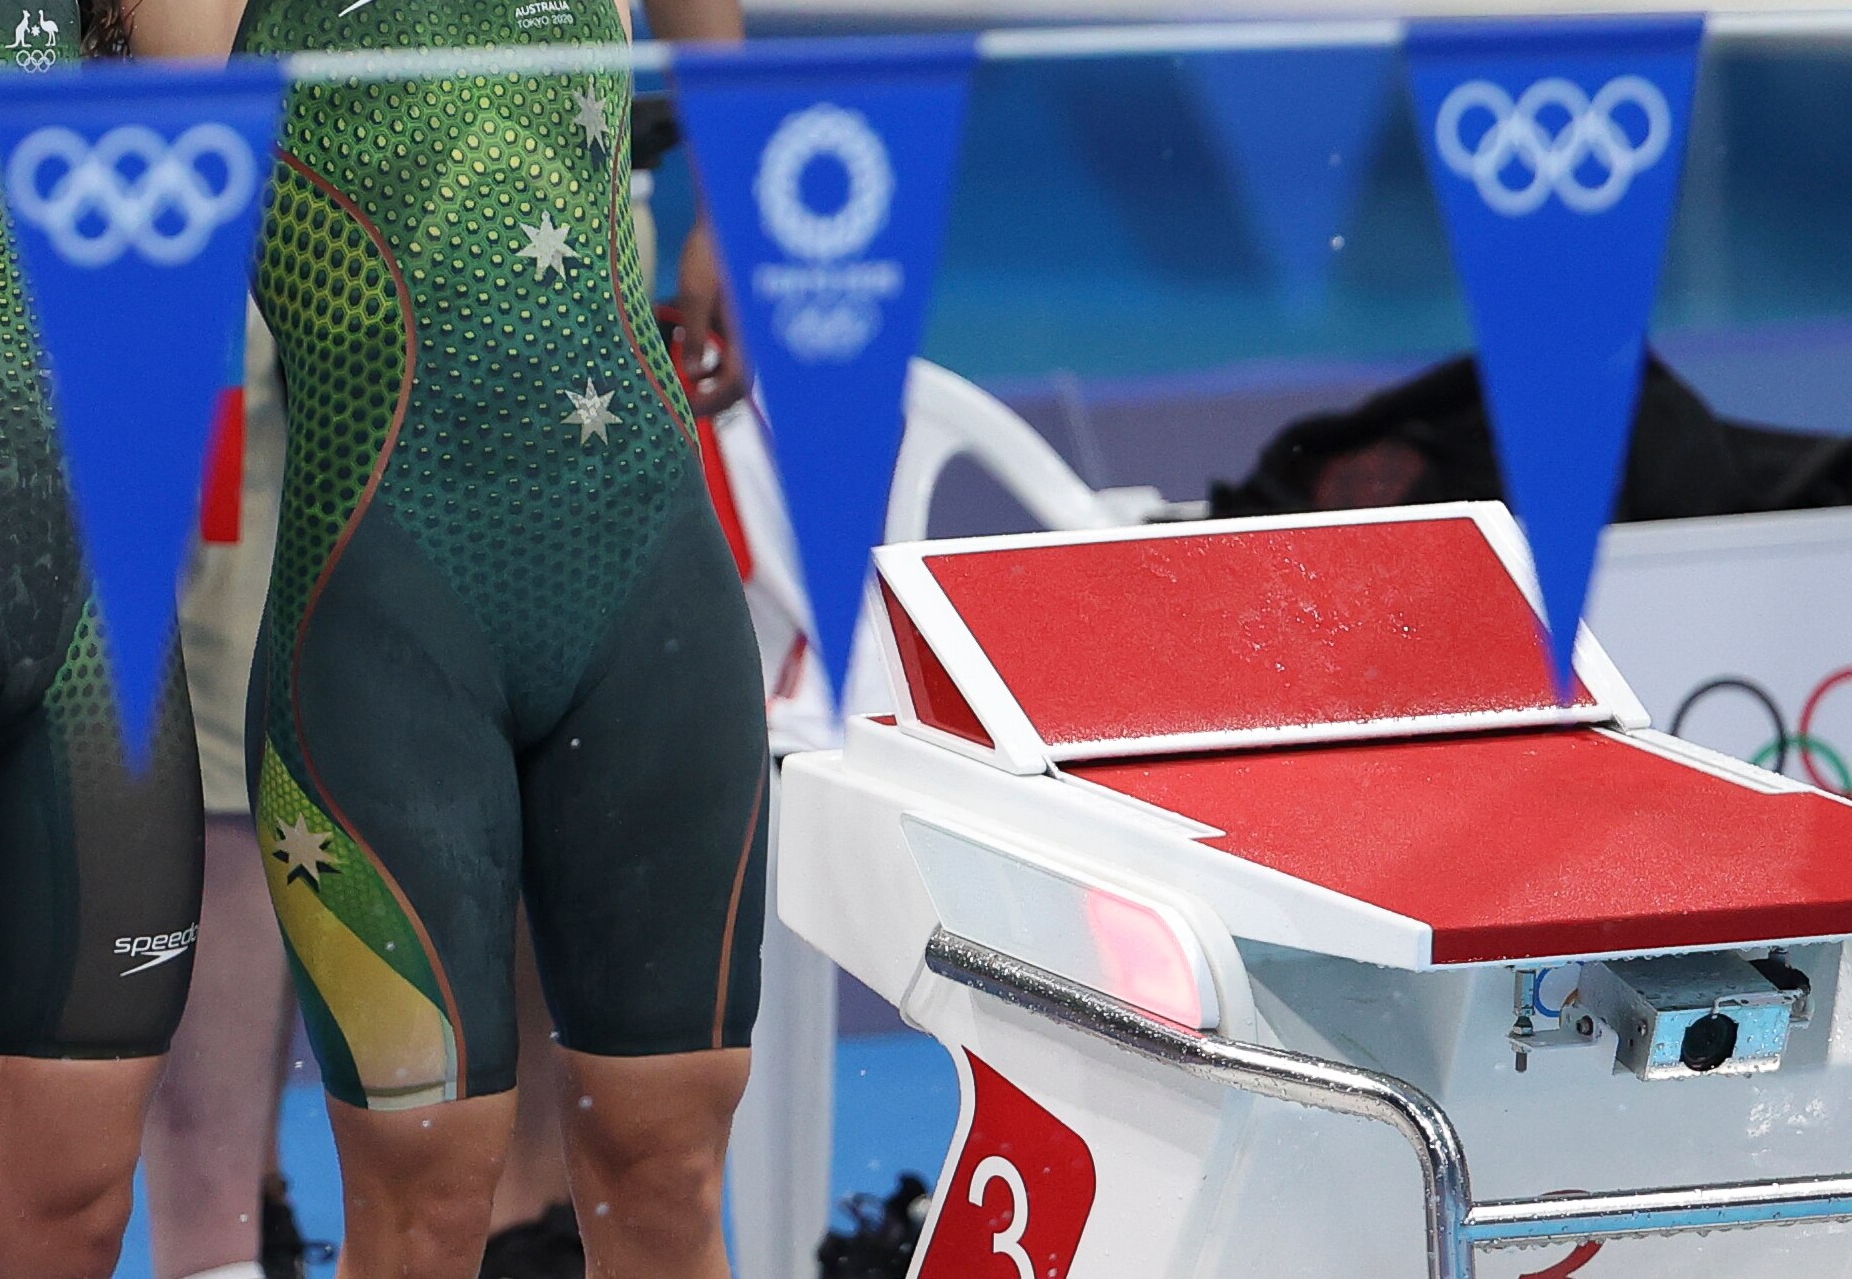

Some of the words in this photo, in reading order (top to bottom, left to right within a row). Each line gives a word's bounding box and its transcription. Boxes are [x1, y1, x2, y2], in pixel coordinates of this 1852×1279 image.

[516, 0, 570, 18] AUSTRALIA
[518, 16, 549, 29] TOKYO
[551, 13, 574, 25] 2020
[968, 1155, 1037, 1279] 3
